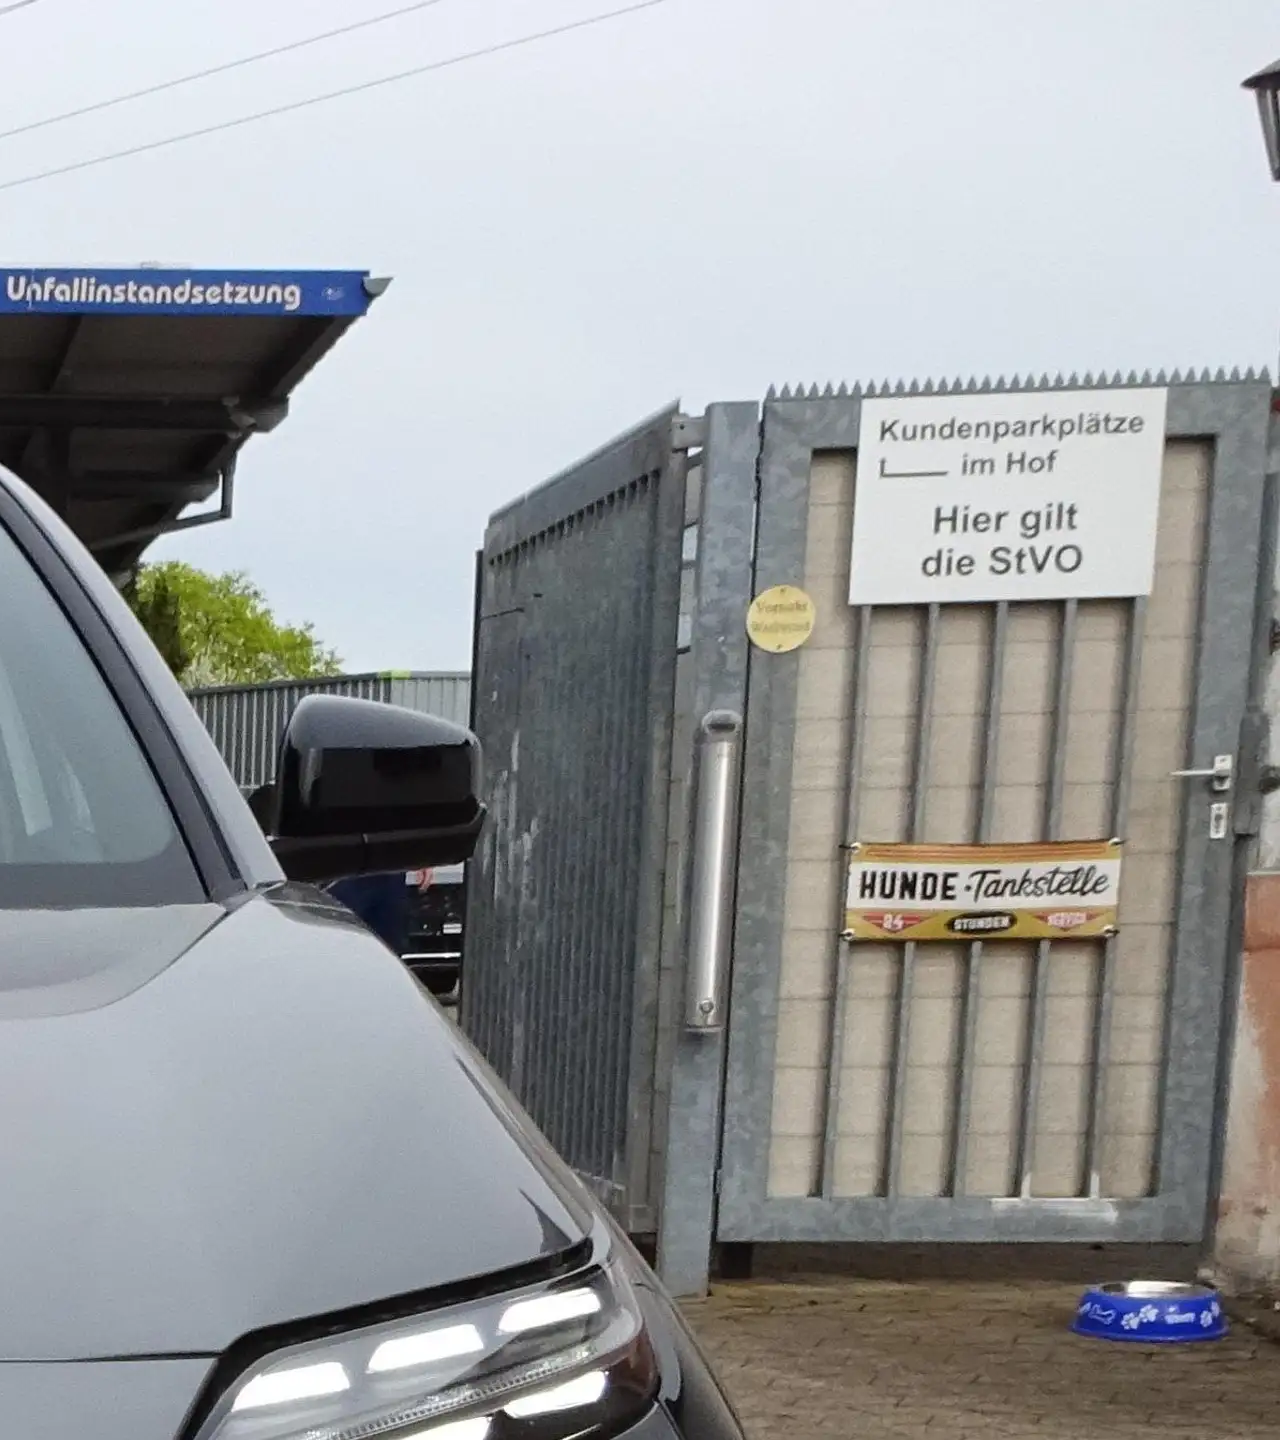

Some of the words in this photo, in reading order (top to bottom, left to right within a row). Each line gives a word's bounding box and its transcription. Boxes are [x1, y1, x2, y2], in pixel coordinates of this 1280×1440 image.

[6, 274, 301, 311] Unfallinstandsetzung
[878, 413, 1146, 443] Kundenparkplätze
[961, 452, 996, 477] im
[1005, 449, 1059, 475] Hof
[932, 505, 1009, 535] Hier
[1019, 501, 1079, 540] gilt
[920, 548, 976, 578] die
[988, 543, 1084, 576] StVO
[858, 870, 960, 901] HUNDE
